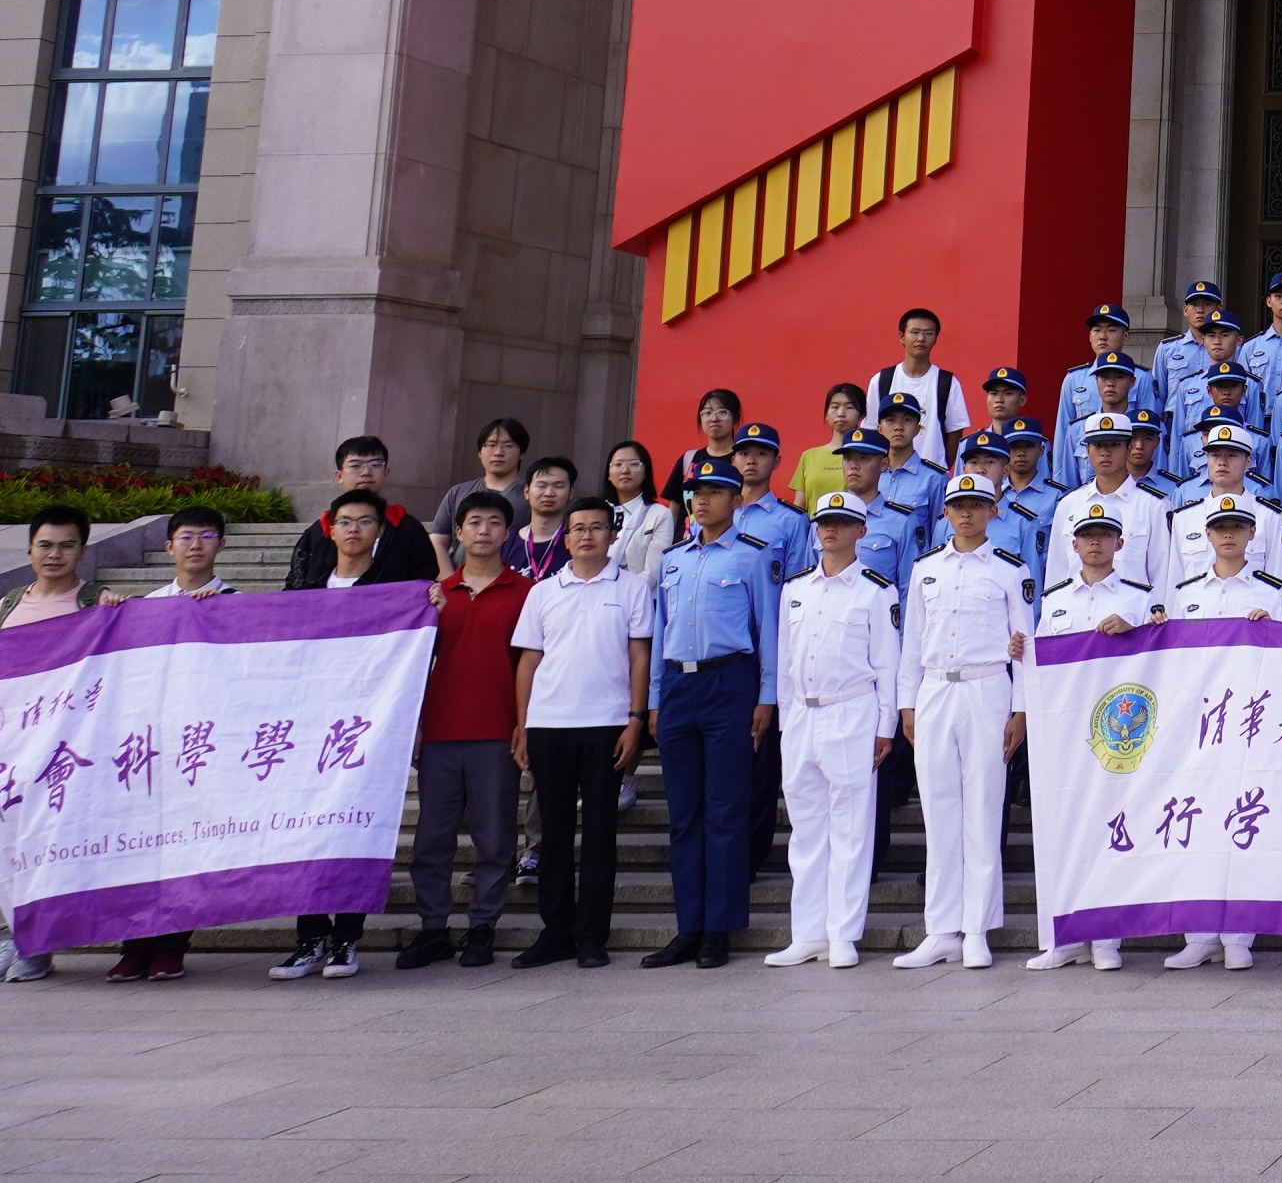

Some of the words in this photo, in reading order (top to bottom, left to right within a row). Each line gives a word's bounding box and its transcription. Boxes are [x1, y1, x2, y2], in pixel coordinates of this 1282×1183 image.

[49, 834, 109, 863] Social
[193, 816, 260, 840] Tsinghua
[271, 806, 376, 830] University
